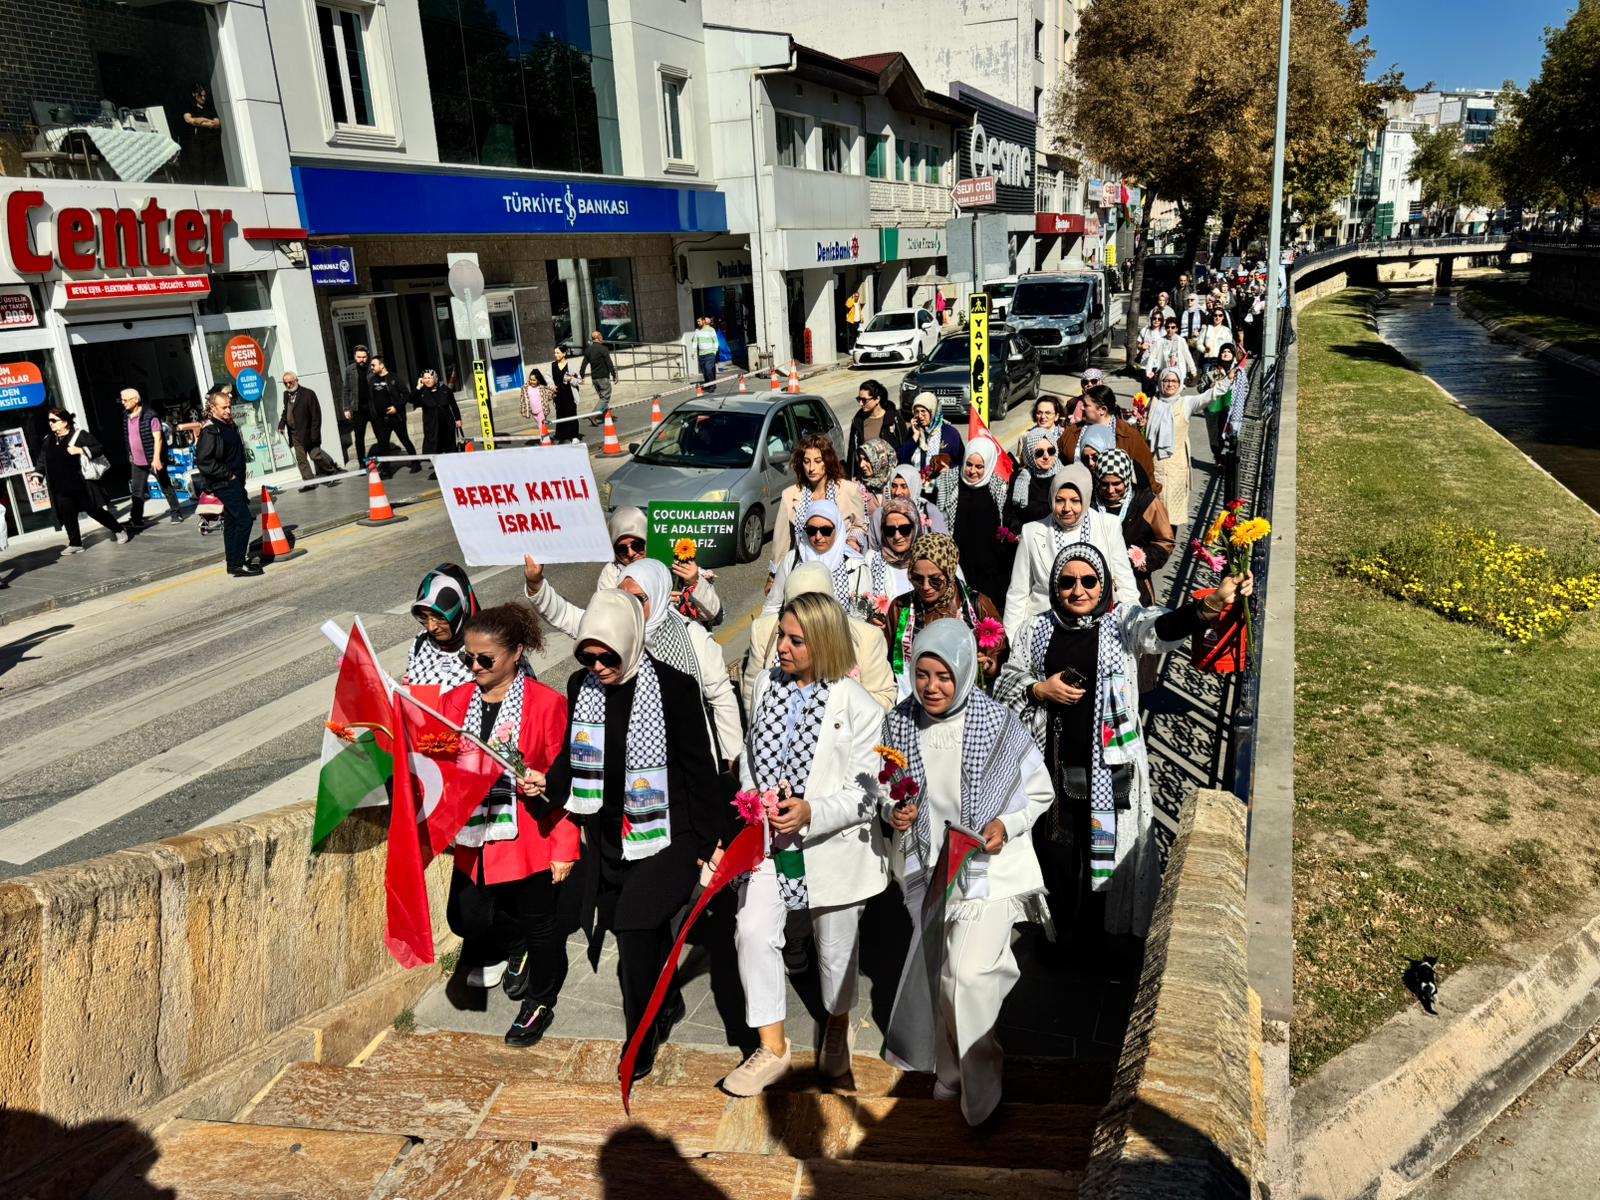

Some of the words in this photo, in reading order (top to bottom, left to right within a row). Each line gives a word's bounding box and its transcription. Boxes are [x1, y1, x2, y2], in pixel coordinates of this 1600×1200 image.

[975, 180, 993, 192] OTEL
[502, 191, 563, 214] TÜRKİYE
[577, 198, 630, 215] BANKASI
[7, 190, 233, 273] Center
[816, 241, 851, 262] DenizBank
[231, 348, 257, 360] PEŞİN
[478, 377, 487, 407] YAYA
[452, 483, 520, 511] BEBEK
[524, 475, 590, 504] KATİLİ
[497, 508, 561, 536] İSRAİL
[653, 509, 735, 521] ÇOCUKLARDAN
[653, 524, 668, 534] VE
[671, 524, 734, 534] ADALETTEN
